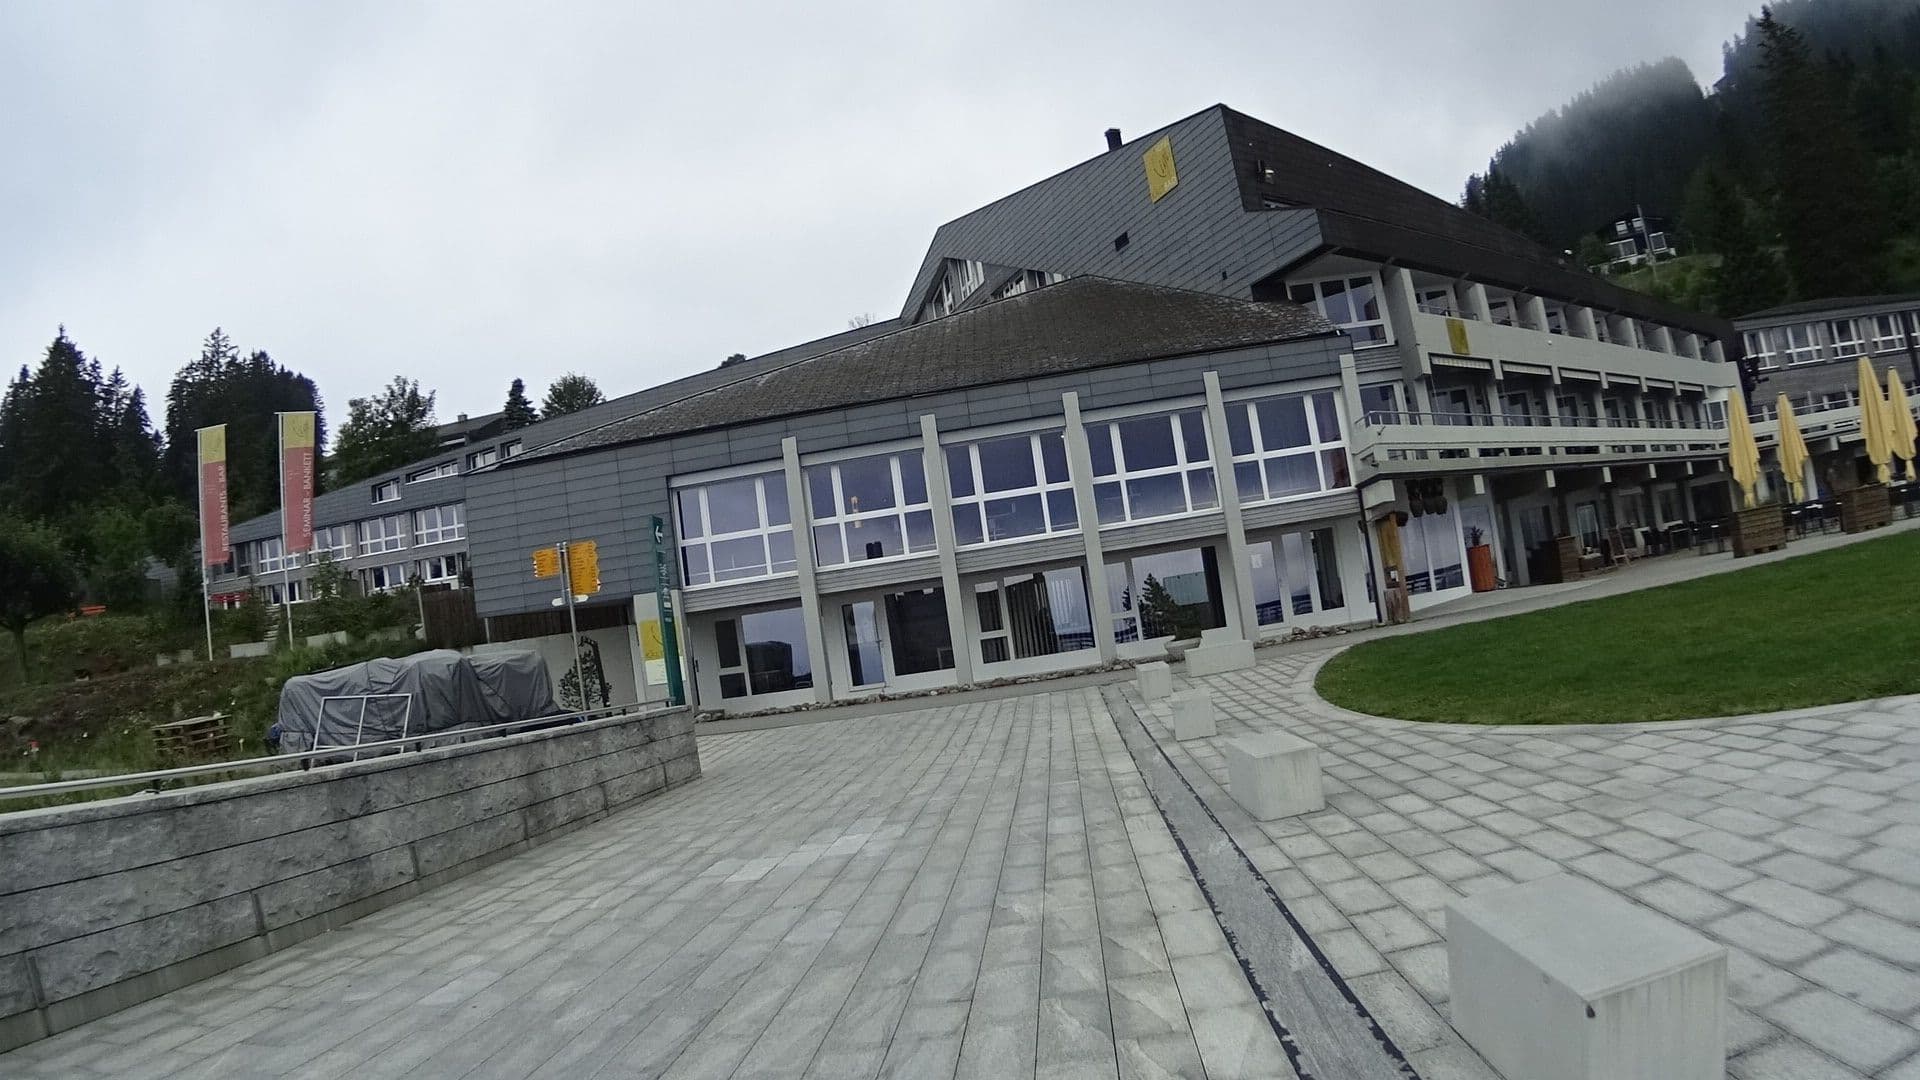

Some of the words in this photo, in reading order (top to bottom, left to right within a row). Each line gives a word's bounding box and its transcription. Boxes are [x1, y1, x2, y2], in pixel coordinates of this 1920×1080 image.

[218, 465, 226, 483] BAR
[303, 452, 312, 490] BANKETT
[219, 490, 230, 552] RESTAURANTS
[303, 498, 312, 538] SEMINAR
